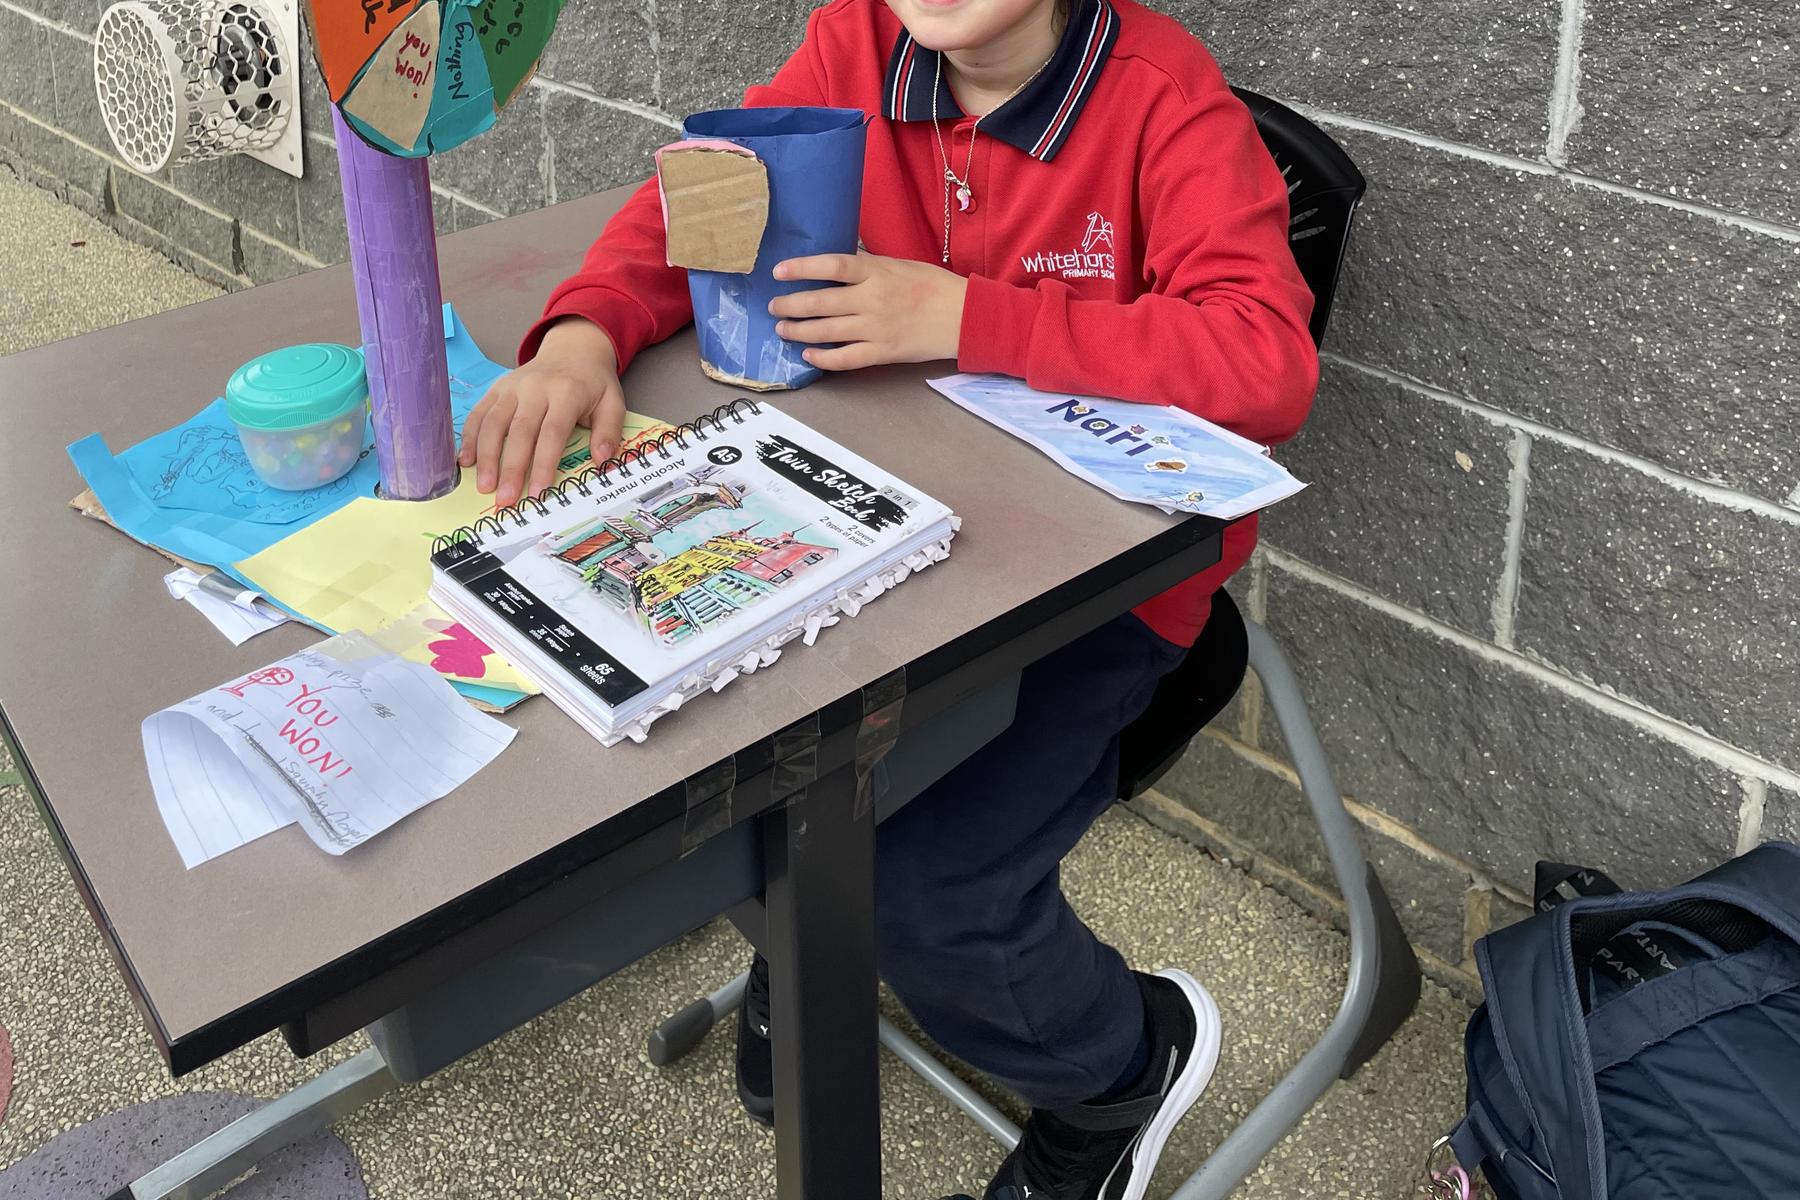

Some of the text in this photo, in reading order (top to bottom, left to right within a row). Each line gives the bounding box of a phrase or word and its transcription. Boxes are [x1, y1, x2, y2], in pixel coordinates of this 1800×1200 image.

[445, 21, 475, 100] Nothing
[1063, 269, 1116, 280] PRIMARY SCH
[712, 448, 738, 464] A5
[595, 458, 686, 505] Alcohol marker
[769, 443, 813, 475] Twin
[813, 469, 877, 505] Sketch
[883, 488, 890, 496] 2
[892, 492, 903, 502] in
[828, 496, 876, 522] Book
[825, 520, 843, 533] types
[842, 529, 850, 538] of
[849, 533, 870, 549] paper
[855, 528, 876, 544] covers
[579, 664, 607, 685] sheets
[594, 662, 616, 676] 65
[285, 683, 339, 727] YOU
[279, 718, 353, 787] WON!
